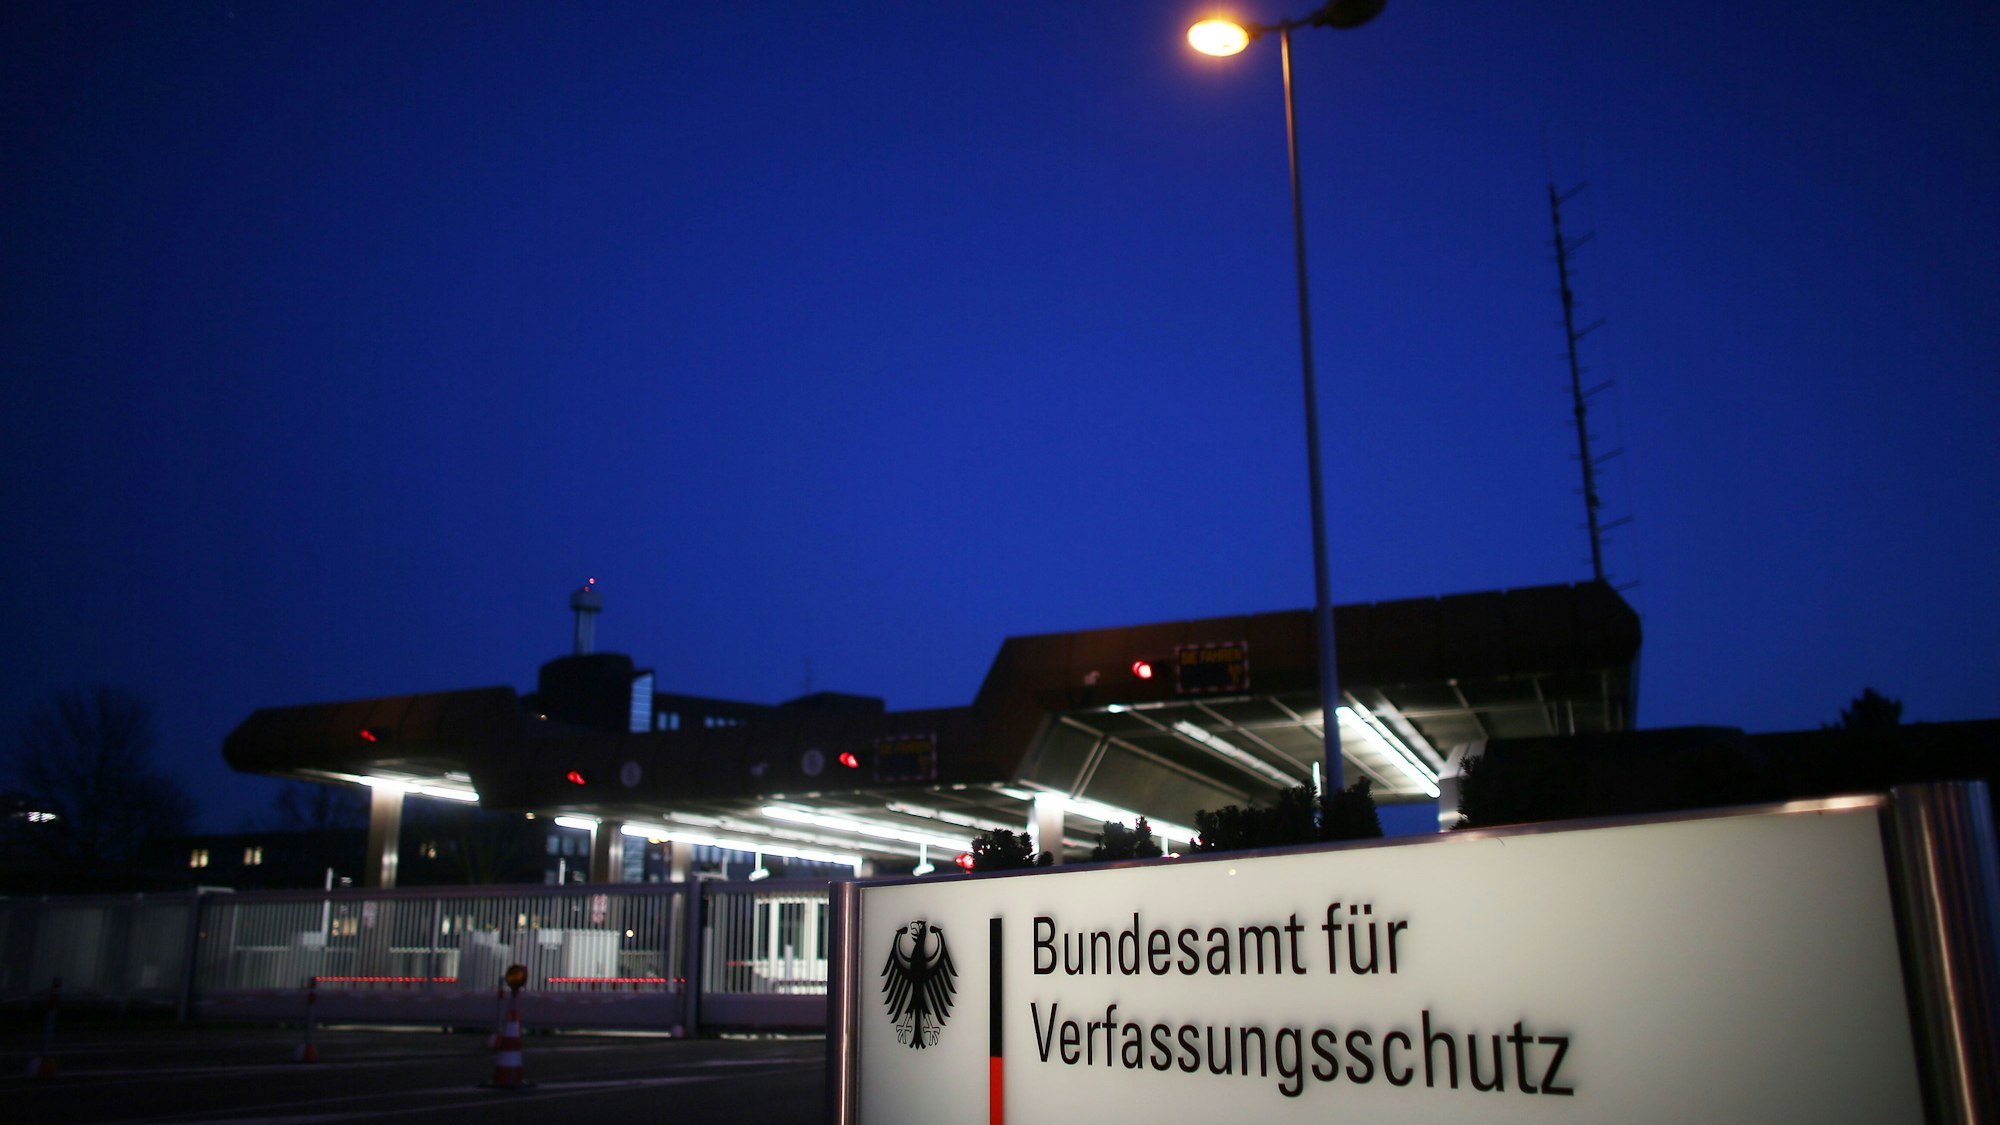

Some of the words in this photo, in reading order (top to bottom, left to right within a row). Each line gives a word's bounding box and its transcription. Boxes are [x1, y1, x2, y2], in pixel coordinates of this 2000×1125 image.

[1033, 912, 1307, 975] Bundesamt
[1322, 903, 1408, 974] für
[1030, 1002, 1574, 1097] Verfassungsschutz
